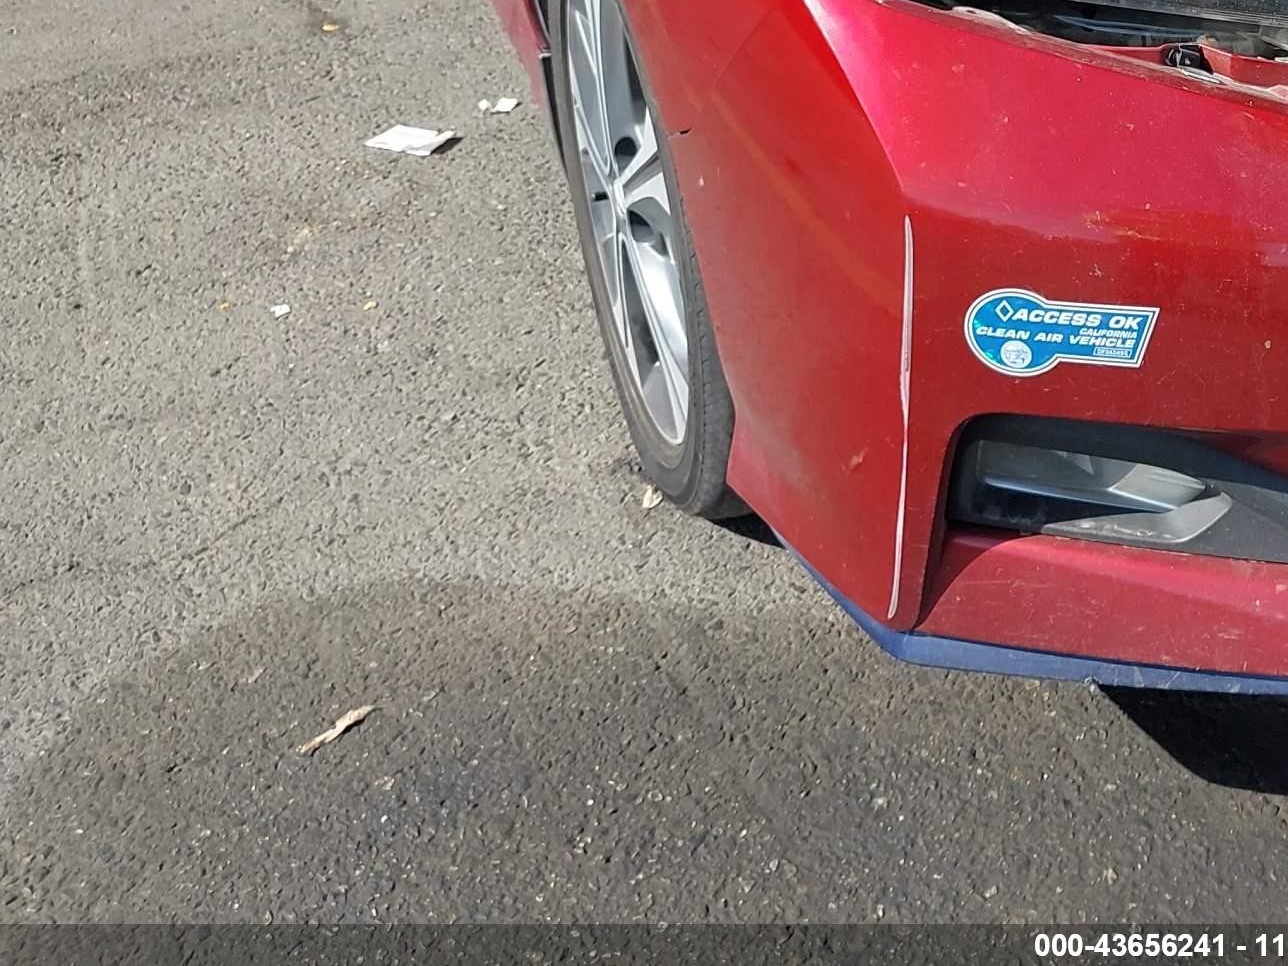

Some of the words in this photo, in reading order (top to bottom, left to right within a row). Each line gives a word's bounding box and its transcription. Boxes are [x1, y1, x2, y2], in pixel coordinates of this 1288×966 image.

[1012, 308, 1102, 327] ACCESS
[1108, 315, 1143, 330] OK
[976, 326, 1030, 340] CLEAN
[1034, 331, 1063, 344] AIR
[1069, 334, 1136, 348] VEHICLE
[1079, 327, 1138, 339] CALIFORNIA
